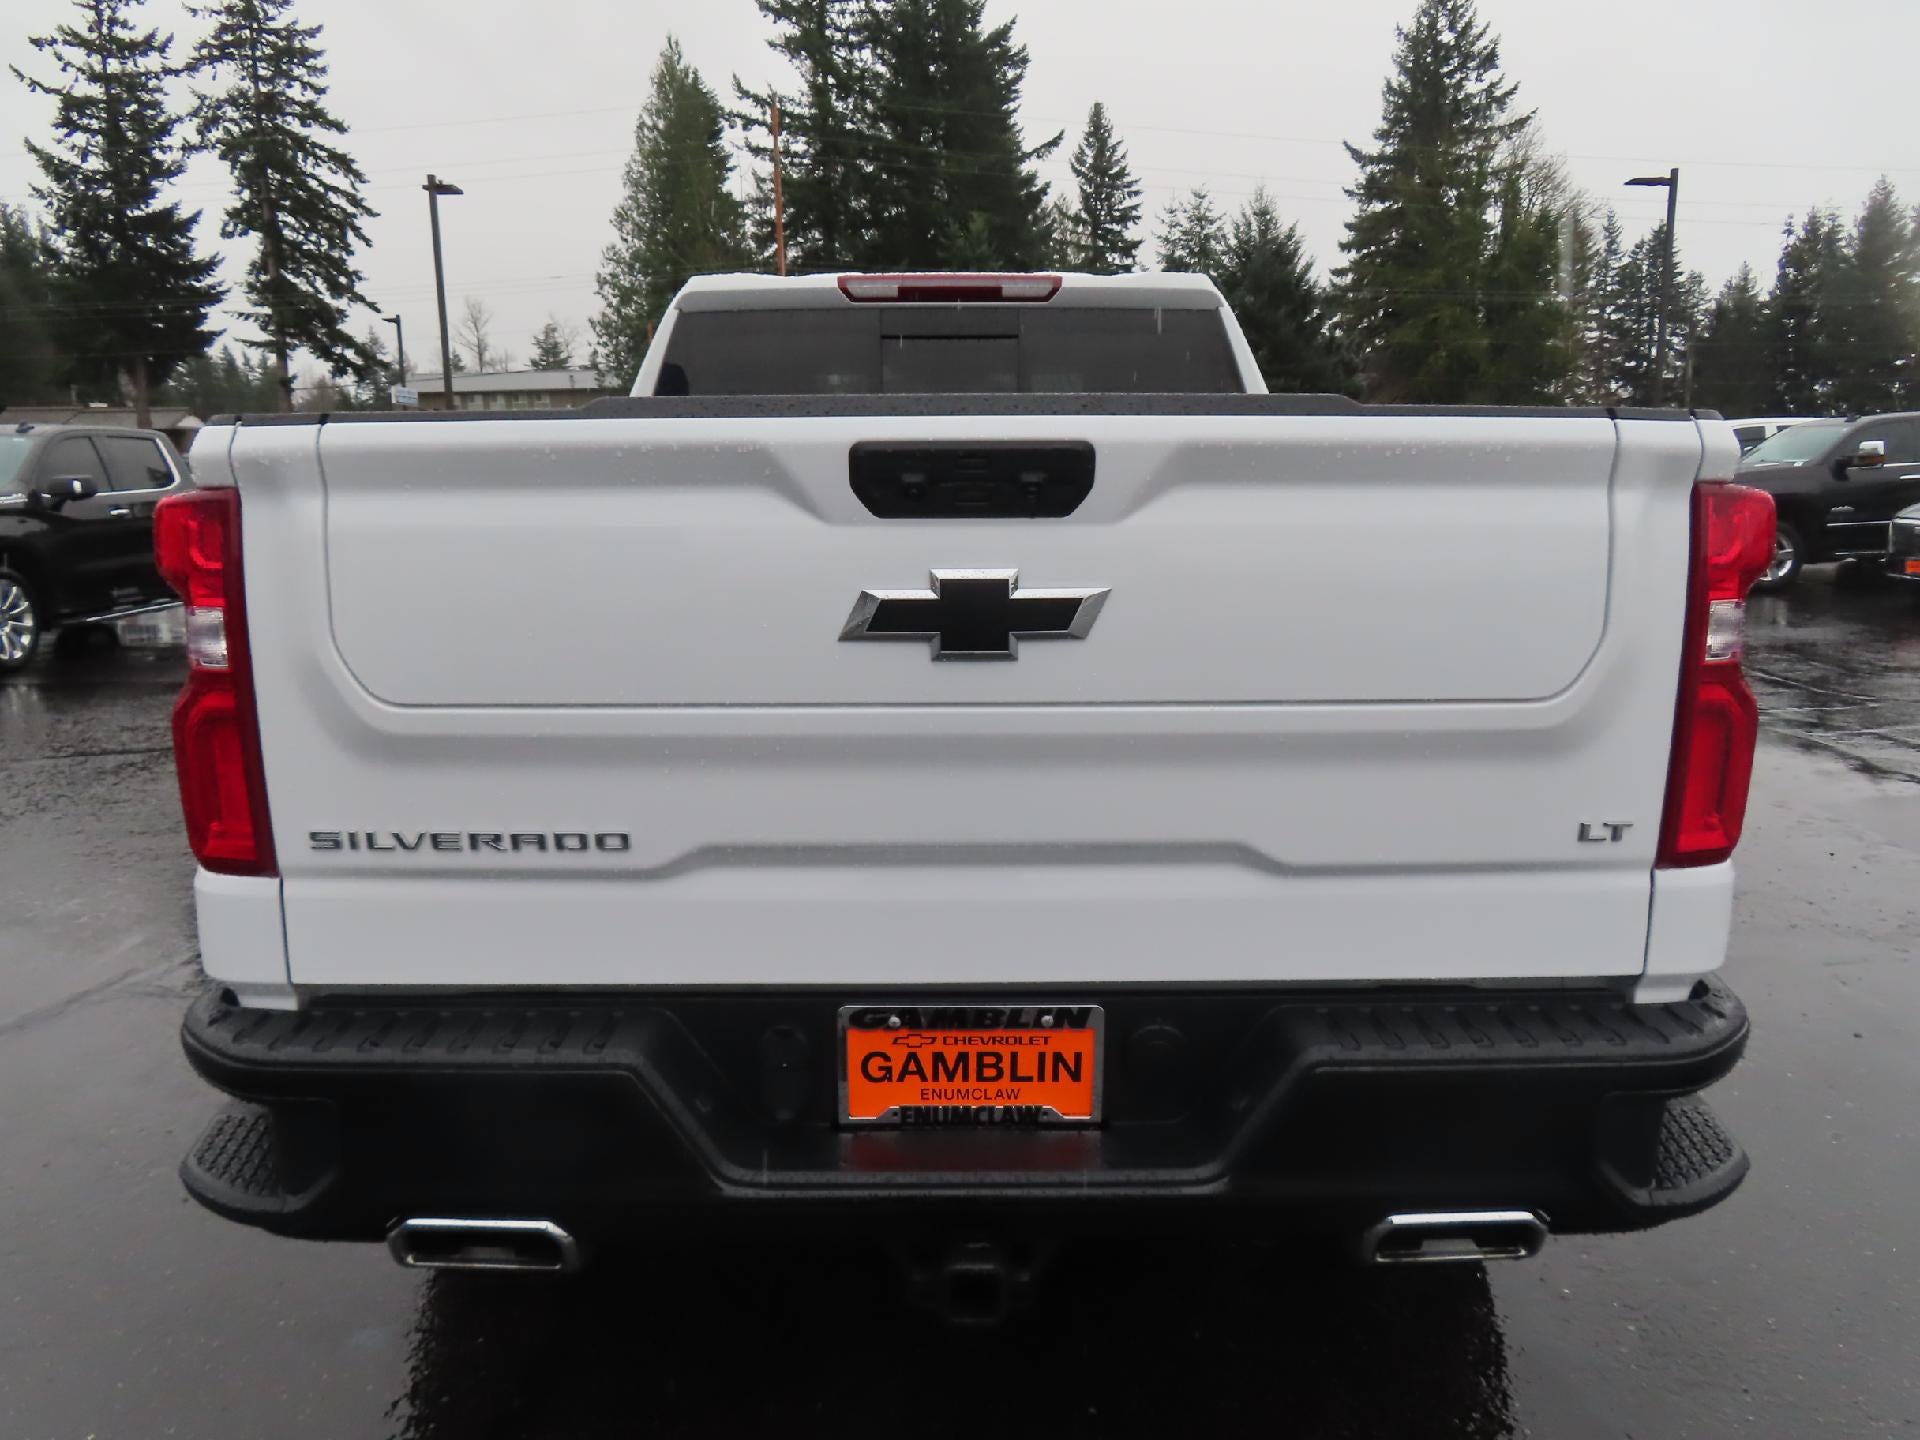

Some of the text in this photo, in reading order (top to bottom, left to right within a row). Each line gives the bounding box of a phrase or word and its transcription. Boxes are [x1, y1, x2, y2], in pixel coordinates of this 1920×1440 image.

[308, 831, 631, 851] SILVERADO
[1577, 822, 1634, 842] LT
[849, 1007, 1092, 1029] GAMBLIN
[942, 1035, 1052, 1046] CHEVROLET
[860, 1051, 1082, 1084] GAMBLIN
[920, 1088, 1020, 1101] ENUMCLAW
[900, 1105, 1043, 1126] ENUMCLAW
